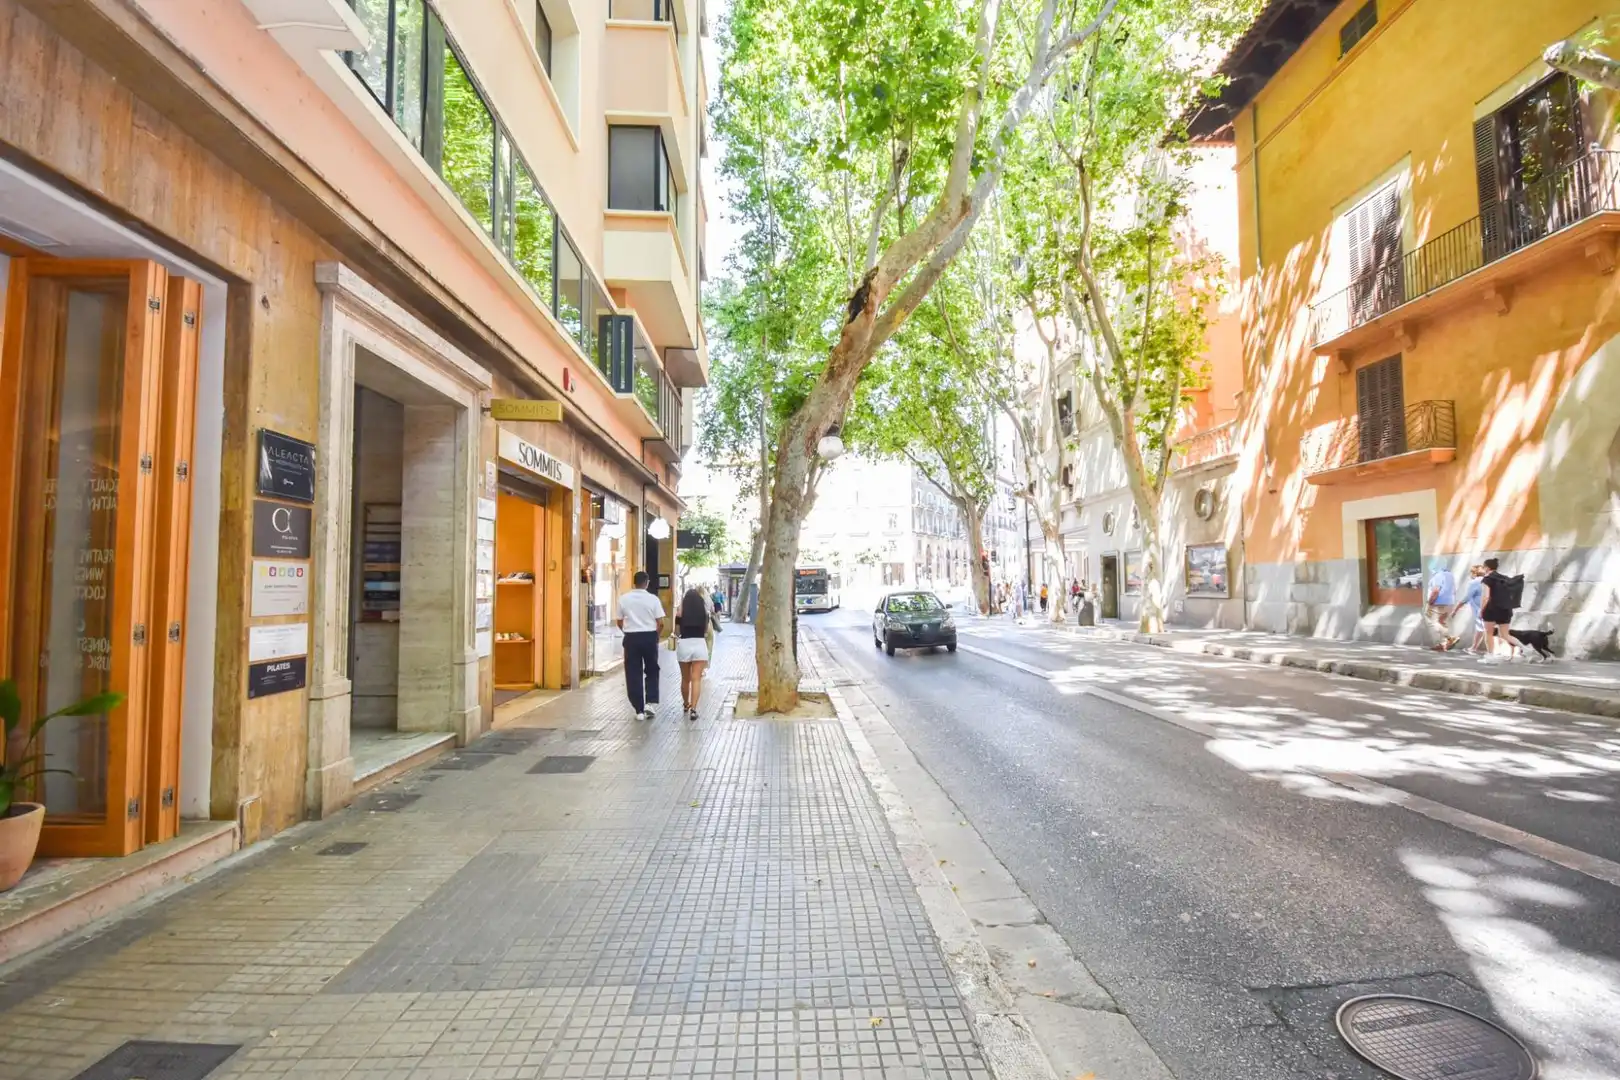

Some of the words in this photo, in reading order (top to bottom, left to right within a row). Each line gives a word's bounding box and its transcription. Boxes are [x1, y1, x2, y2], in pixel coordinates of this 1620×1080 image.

[498, 404, 552, 415] SOMMITS
[267, 446, 309, 465] ALEACTA
[518, 442, 562, 481] SOMMITS
[266, 662, 291, 673] PILATES
